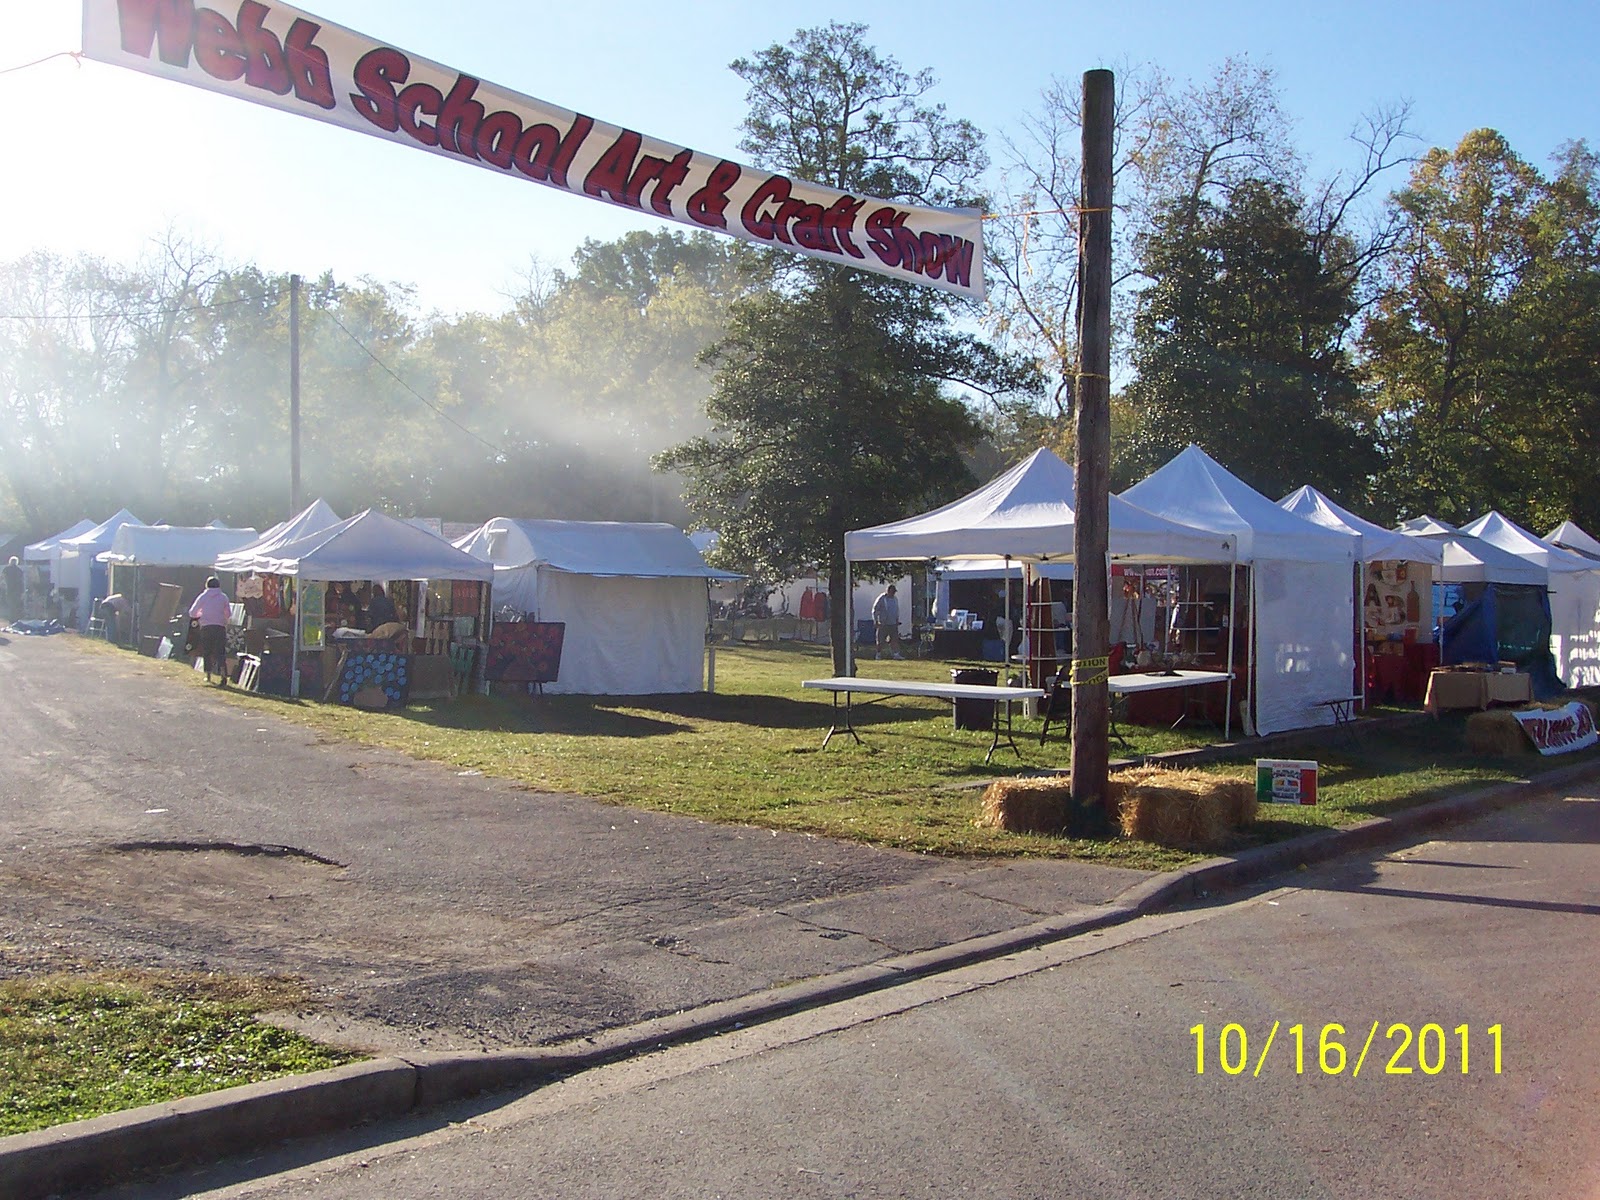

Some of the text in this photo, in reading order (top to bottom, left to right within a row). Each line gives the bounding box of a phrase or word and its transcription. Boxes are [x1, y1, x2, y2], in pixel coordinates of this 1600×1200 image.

[116, 0, 974, 288] Webb School Art & Craft Show
